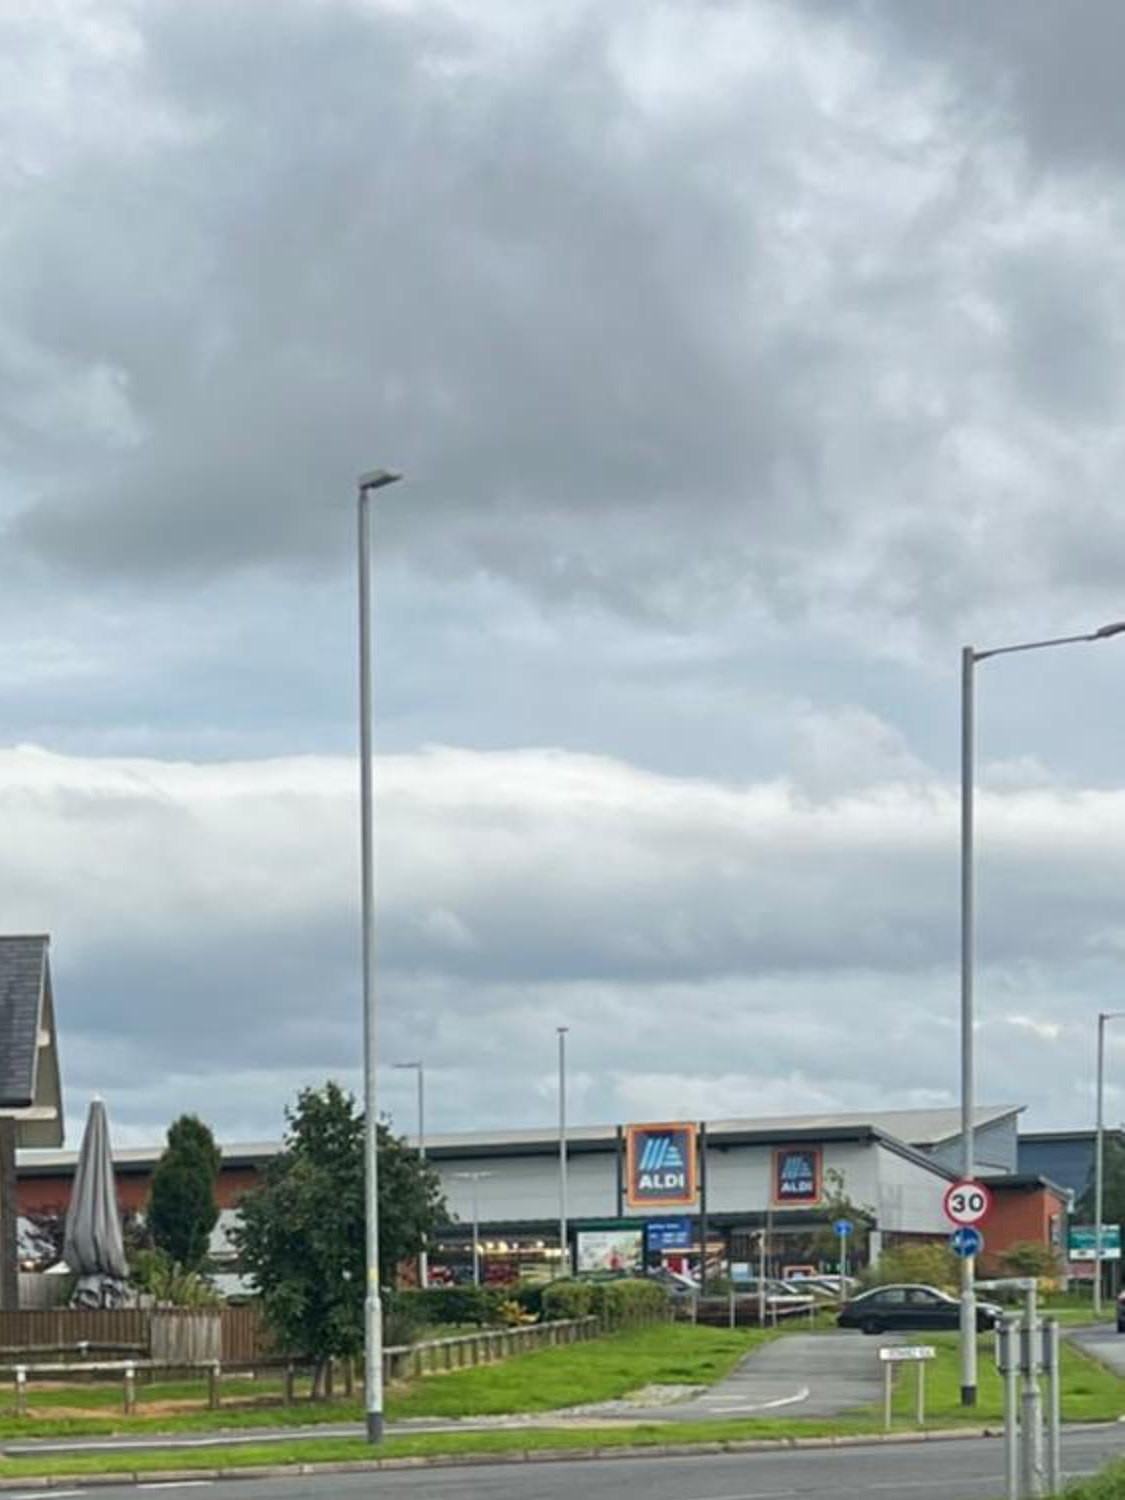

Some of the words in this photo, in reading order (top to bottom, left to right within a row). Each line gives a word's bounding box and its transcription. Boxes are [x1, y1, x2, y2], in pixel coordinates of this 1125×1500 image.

[638, 1173, 684, 1190] ALDI
[781, 1181, 813, 1193] ALDI
[952, 1194, 984, 1213] 30
